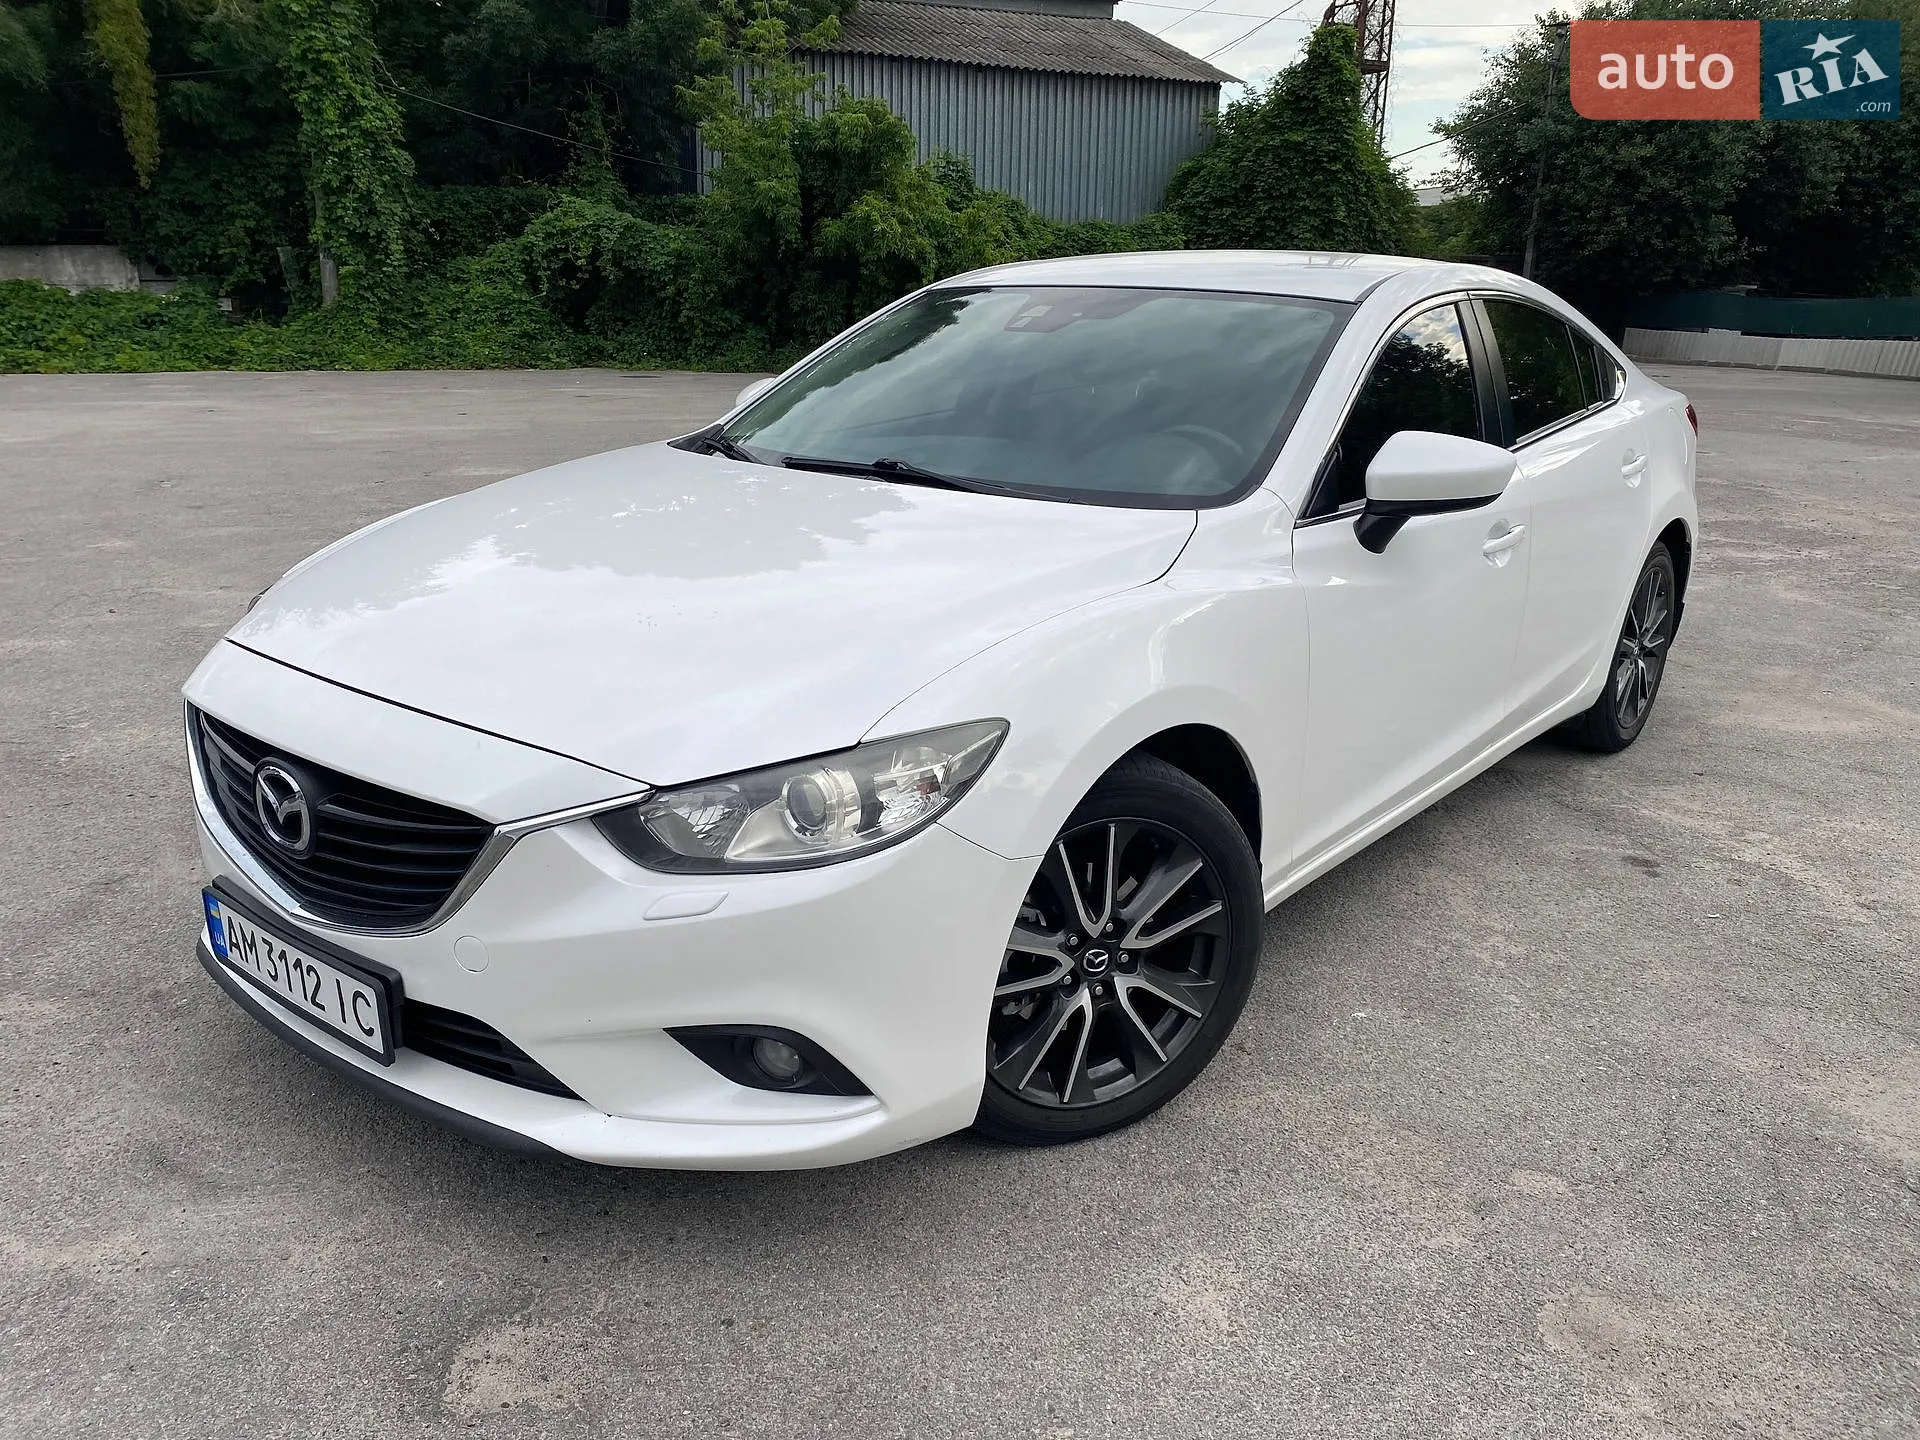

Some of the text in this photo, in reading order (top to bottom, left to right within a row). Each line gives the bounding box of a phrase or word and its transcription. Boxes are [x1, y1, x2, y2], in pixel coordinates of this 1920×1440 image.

[215, 932, 226, 948] UA
[227, 915, 375, 1037] AM 3112 IC
